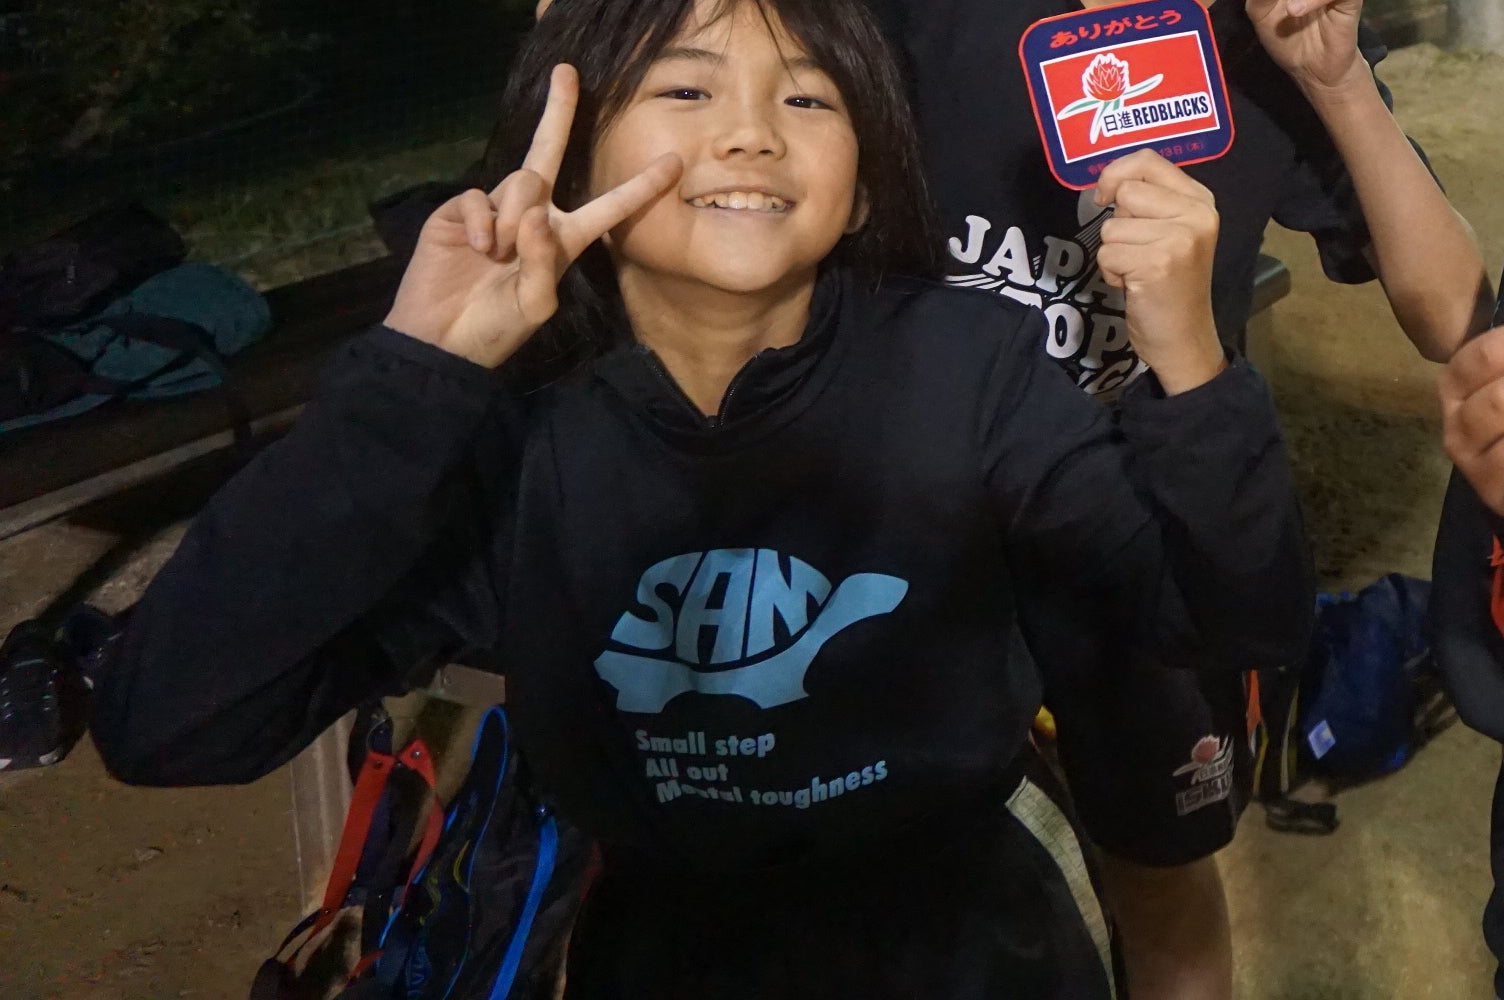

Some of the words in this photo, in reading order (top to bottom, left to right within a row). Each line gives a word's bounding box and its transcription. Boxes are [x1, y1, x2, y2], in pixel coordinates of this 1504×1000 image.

[1050, 9, 1182, 49] ありがとう
[635, 729, 706, 755] Small
[715, 732, 776, 758] step
[646, 757, 679, 778] All
[686, 763, 728, 782] out
[751, 760, 889, 809] toughness
